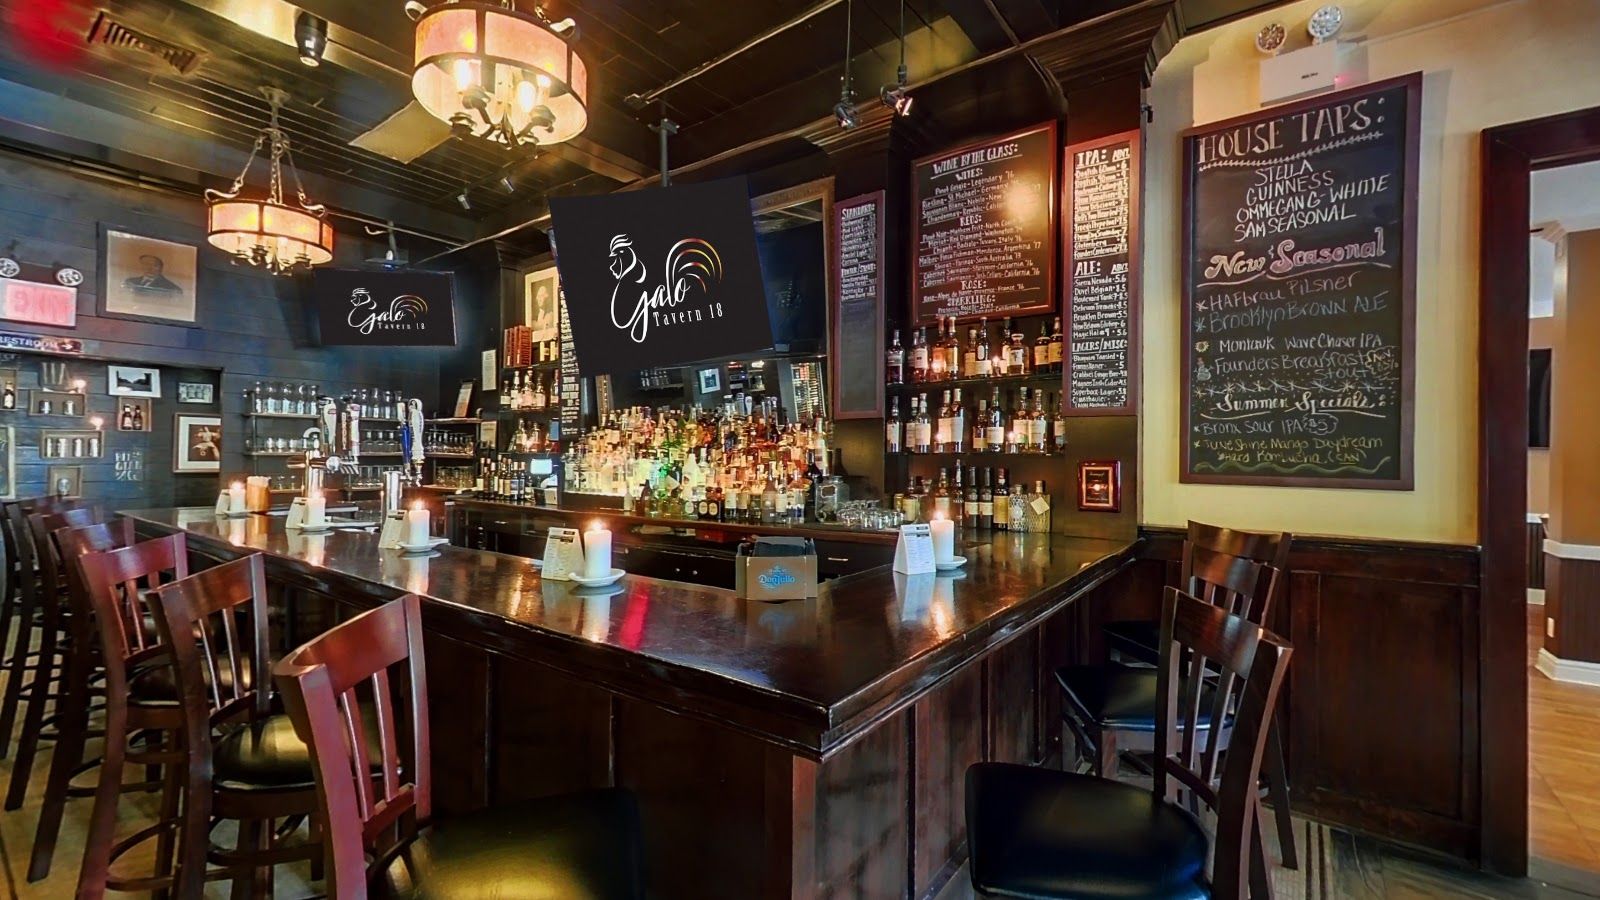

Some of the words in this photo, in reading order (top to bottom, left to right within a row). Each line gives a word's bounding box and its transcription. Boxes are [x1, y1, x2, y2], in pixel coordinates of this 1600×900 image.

[1197, 118, 1284, 163] HOUSE
[1292, 97, 1385, 143] TAPS:
[933, 158, 959, 175] WINE
[961, 154, 970, 167] BY
[971, 150, 985, 165] THE
[987, 143, 1019, 161] GLASS:
[1077, 149, 1107, 167] IPA:
[1255, 160, 1313, 187] STELLA
[1246, 170, 1334, 206] GUINNESS
[960, 214, 981, 227] REDS:
[1234, 222, 1266, 242] SAM
[1268, 203, 1356, 234] SEASONAL
[1205, 251, 1266, 279] New
[1270, 227, 1386, 273] Seasonal
[1075, 261, 1101, 276] ALE:
[960, 278, 987, 291] ROSE:
[1115, 274, 1127, 283] 5.6
[947, 293, 996, 308] SPARKLING:
[652, 308, 703, 327] Tavern
[709, 302, 724, 319] 18
[1210, 306, 1285, 333] Brooklyn
[1354, 290, 1389, 313] ALE
[377, 321, 412, 331] Tavern
[416, 322, 425, 331] 18
[1360, 332, 1382, 348] IPA
[1215, 357, 1279, 375] Founders
[1216, 394, 1289, 411] Summer
[1200, 421, 1241, 435] Bronx
[1281, 419, 1303, 434] IPA
[1271, 437, 1309, 453] Mango
[1312, 436, 1383, 452] Daydream
